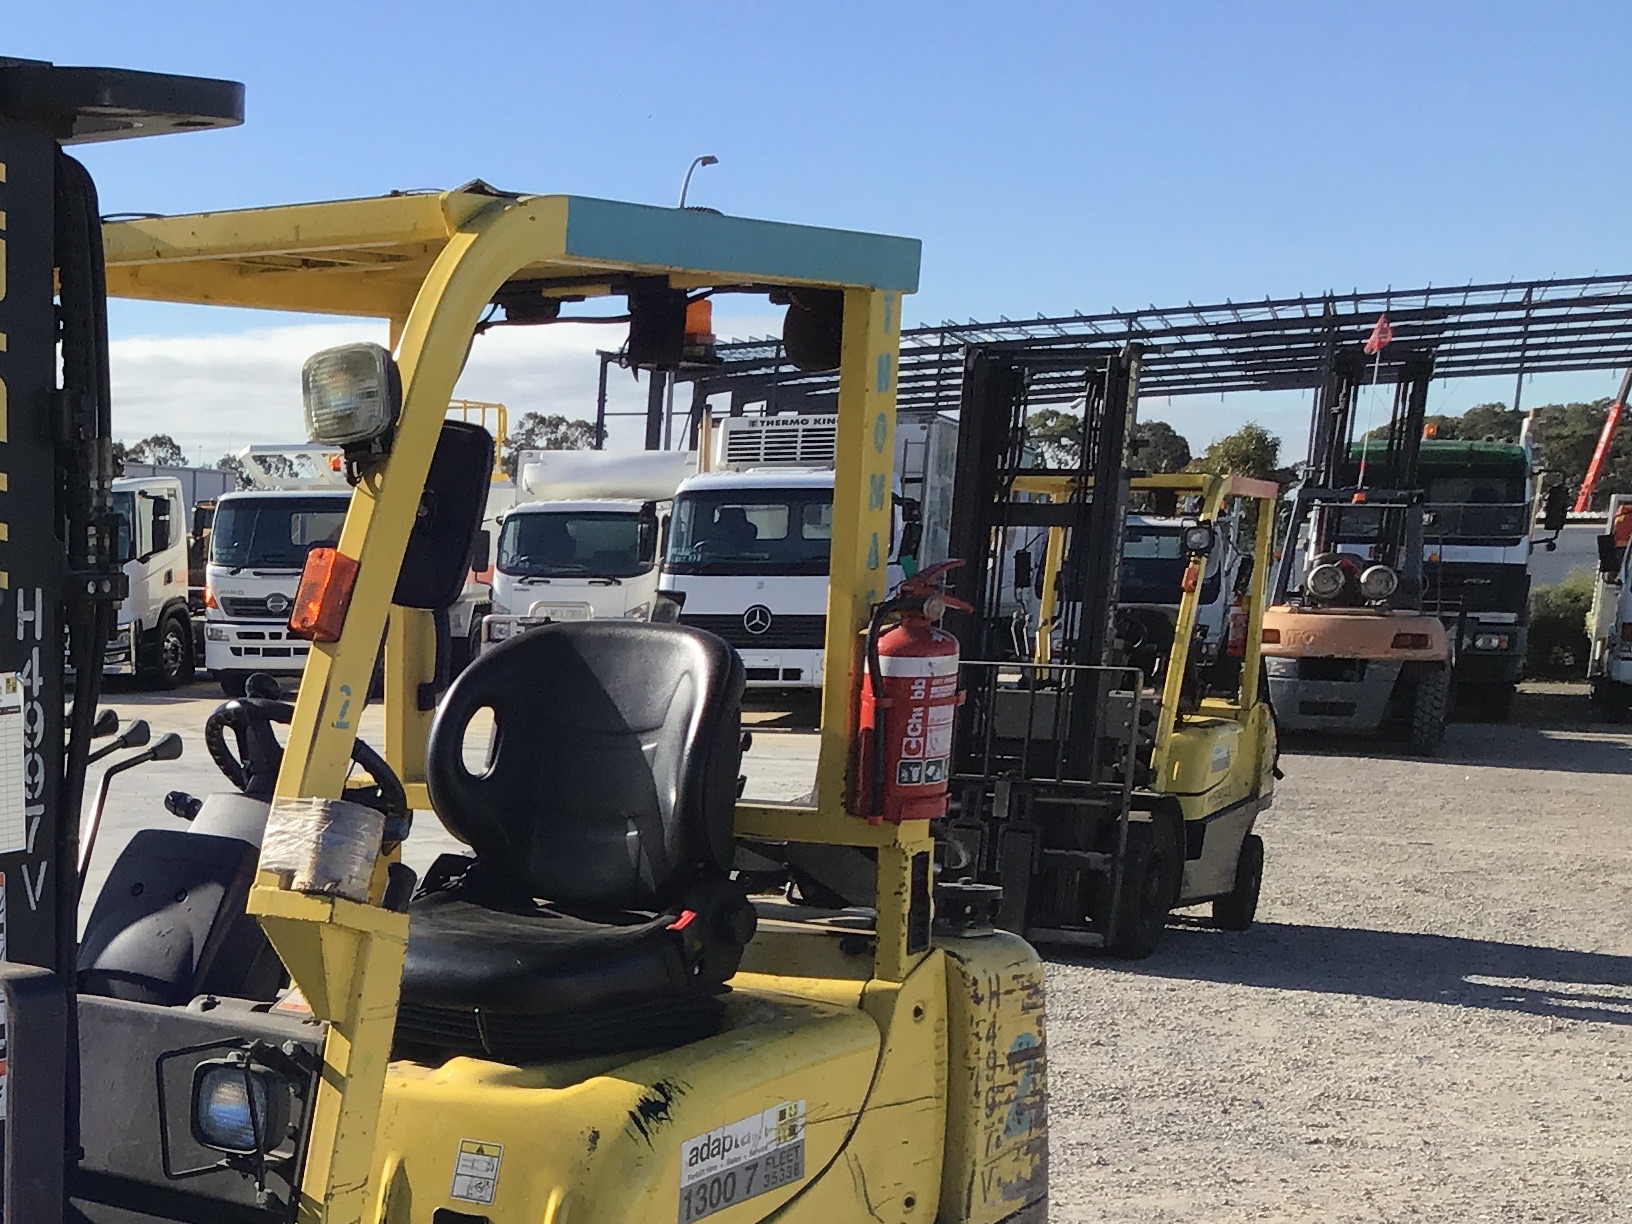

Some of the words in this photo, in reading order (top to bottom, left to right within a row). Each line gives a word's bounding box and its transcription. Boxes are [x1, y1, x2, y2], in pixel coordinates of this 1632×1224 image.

[759, 418, 809, 427] THERMO
[813, 417, 838, 425] KIN
[765, 1144, 800, 1171] FLEET
[683, 1171, 737, 1221] 1300
[744, 1162, 759, 1195] 7
